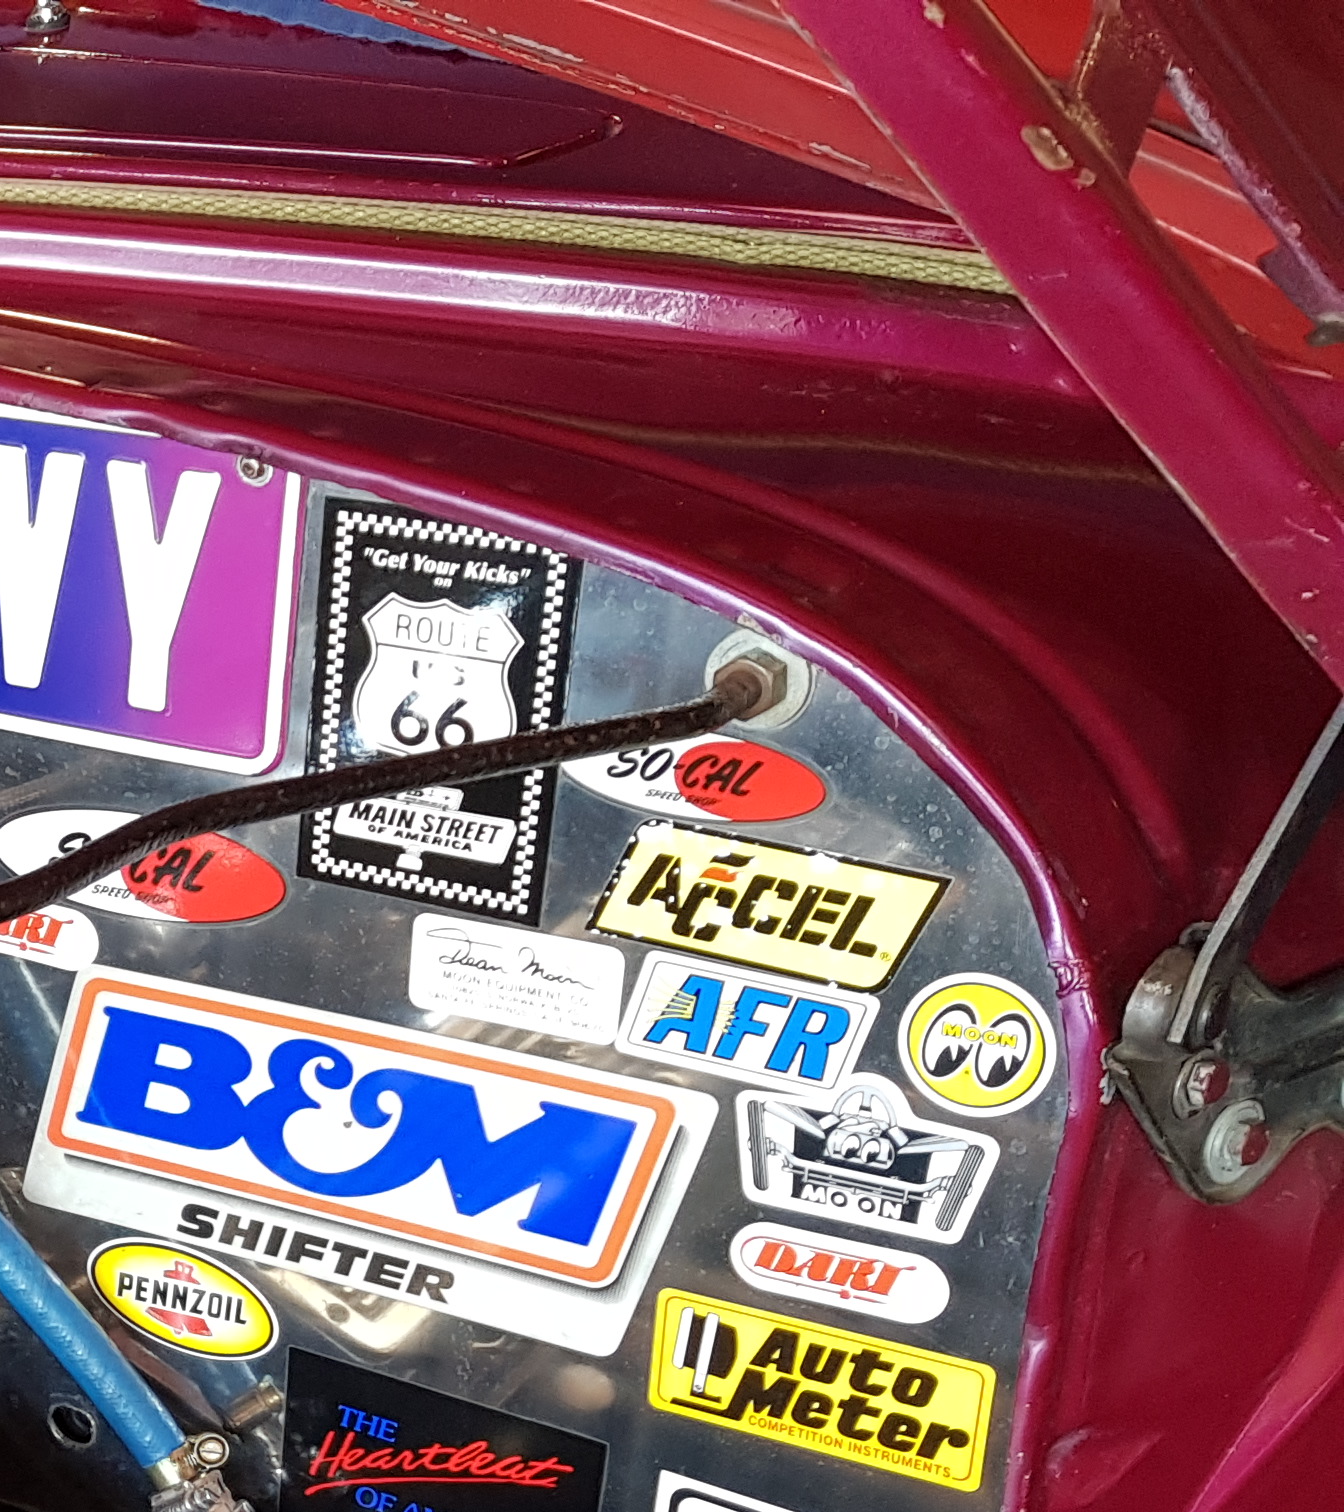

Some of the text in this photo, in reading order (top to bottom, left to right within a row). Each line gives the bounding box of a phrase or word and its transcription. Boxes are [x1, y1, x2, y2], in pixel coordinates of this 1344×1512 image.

[412, 553, 461, 577] Your
[433, 576, 454, 589] on
[395, 613, 491, 653] ROUTE
[390, 690, 475, 750] 66
[606, 747, 765, 797] SO-CAL
[645, 788, 683, 802] SPEED
[348, 801, 504, 845] MAIN STREET
[367, 824, 473, 852] OF AMERICA
[91, 883, 132, 901] SPEED
[627, 853, 878, 959] ACCEL
[643, 974, 851, 1082] AFR
[941, 1020, 1019, 1050] MOON
[76, 1004, 639, 1248] B&M
[799, 1182, 905, 1221] MOON
[176, 1202, 455, 1306] SHIFTER
[116, 1270, 249, 1328] PENNZOIL
[750, 1326, 940, 1408] Auto
[337, 1403, 400, 1444] THE
[722, 1366, 972, 1460] Meter
[306, 1429, 576, 1490] Heartbeat
[747, 1414, 952, 1479] COMPETITION INSTRUMENTS
